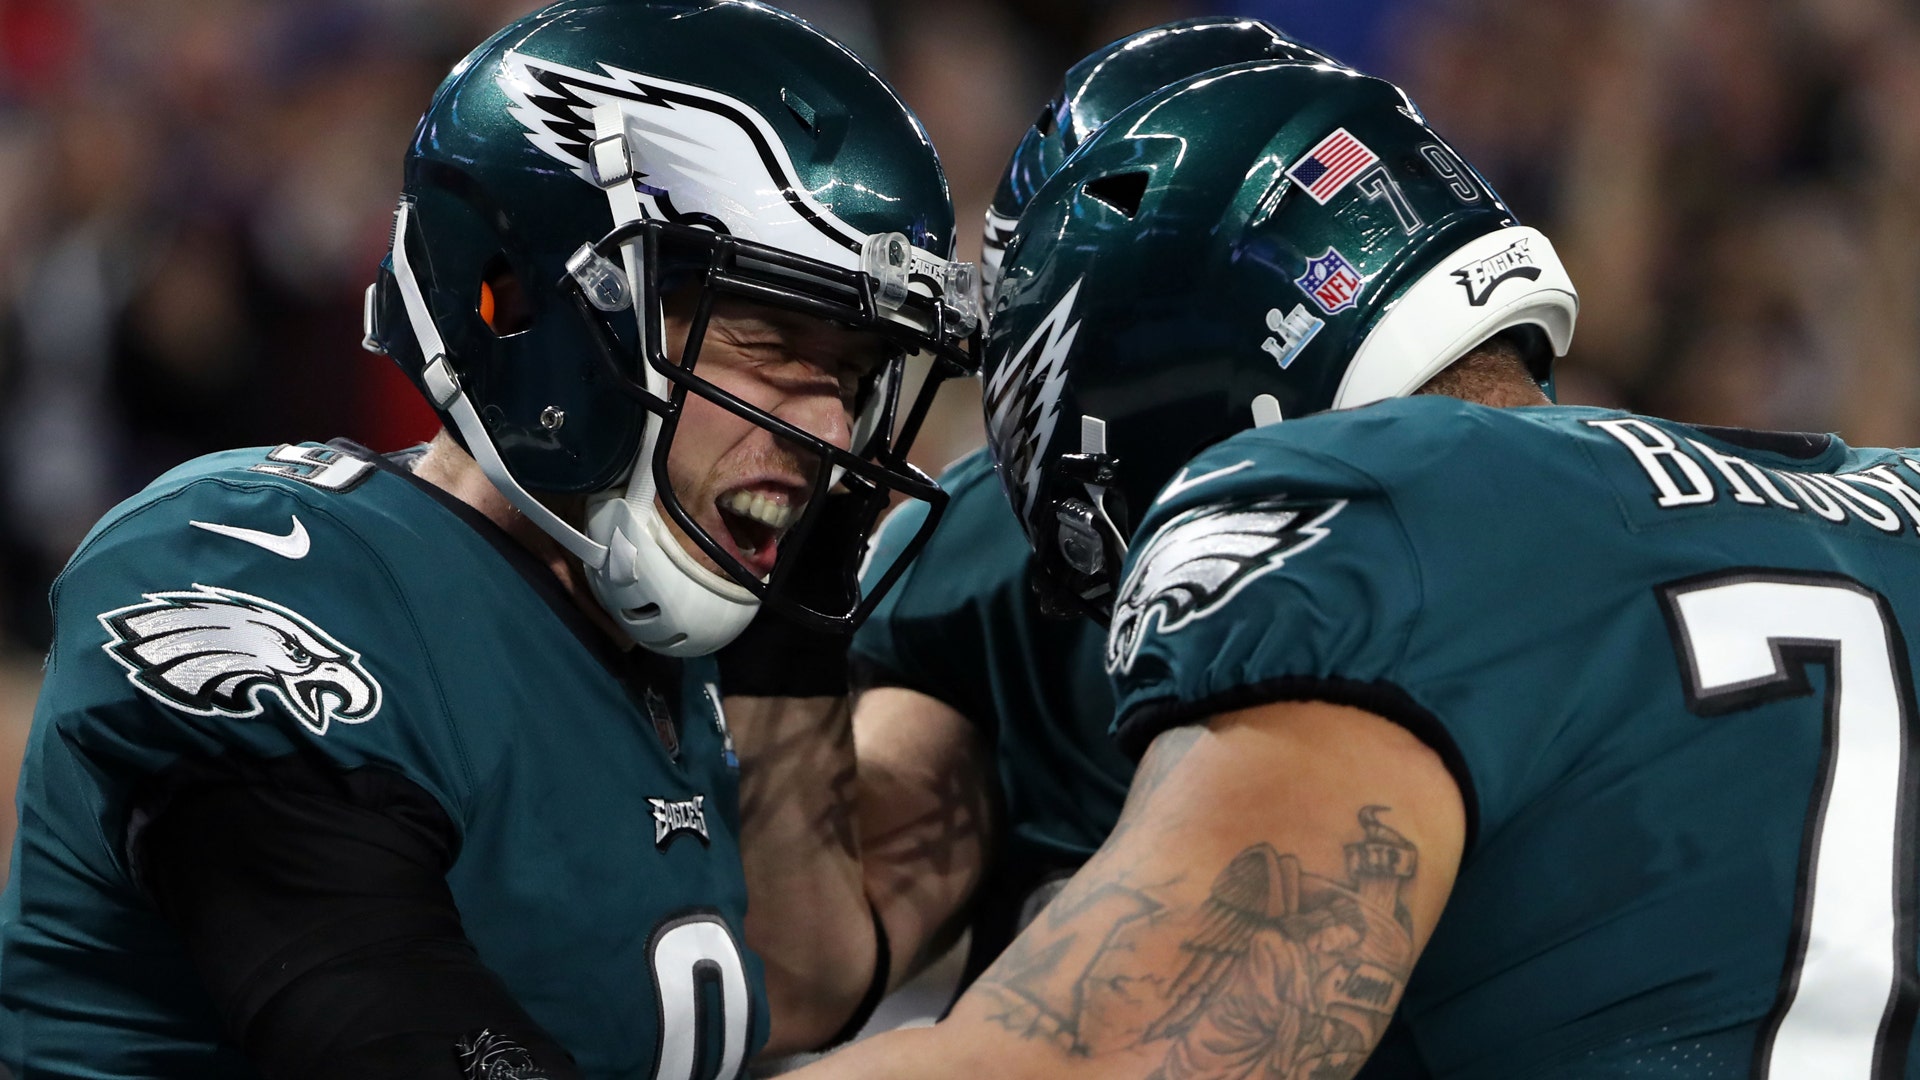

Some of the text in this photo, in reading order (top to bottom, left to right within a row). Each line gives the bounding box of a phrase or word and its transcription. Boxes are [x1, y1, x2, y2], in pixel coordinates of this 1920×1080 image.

[1356, 166, 1424, 236] 7
[1316, 271, 1359, 310] NFL
[1450, 237, 1542, 307] EAGLES
[647, 795, 711, 850] EAGLES
